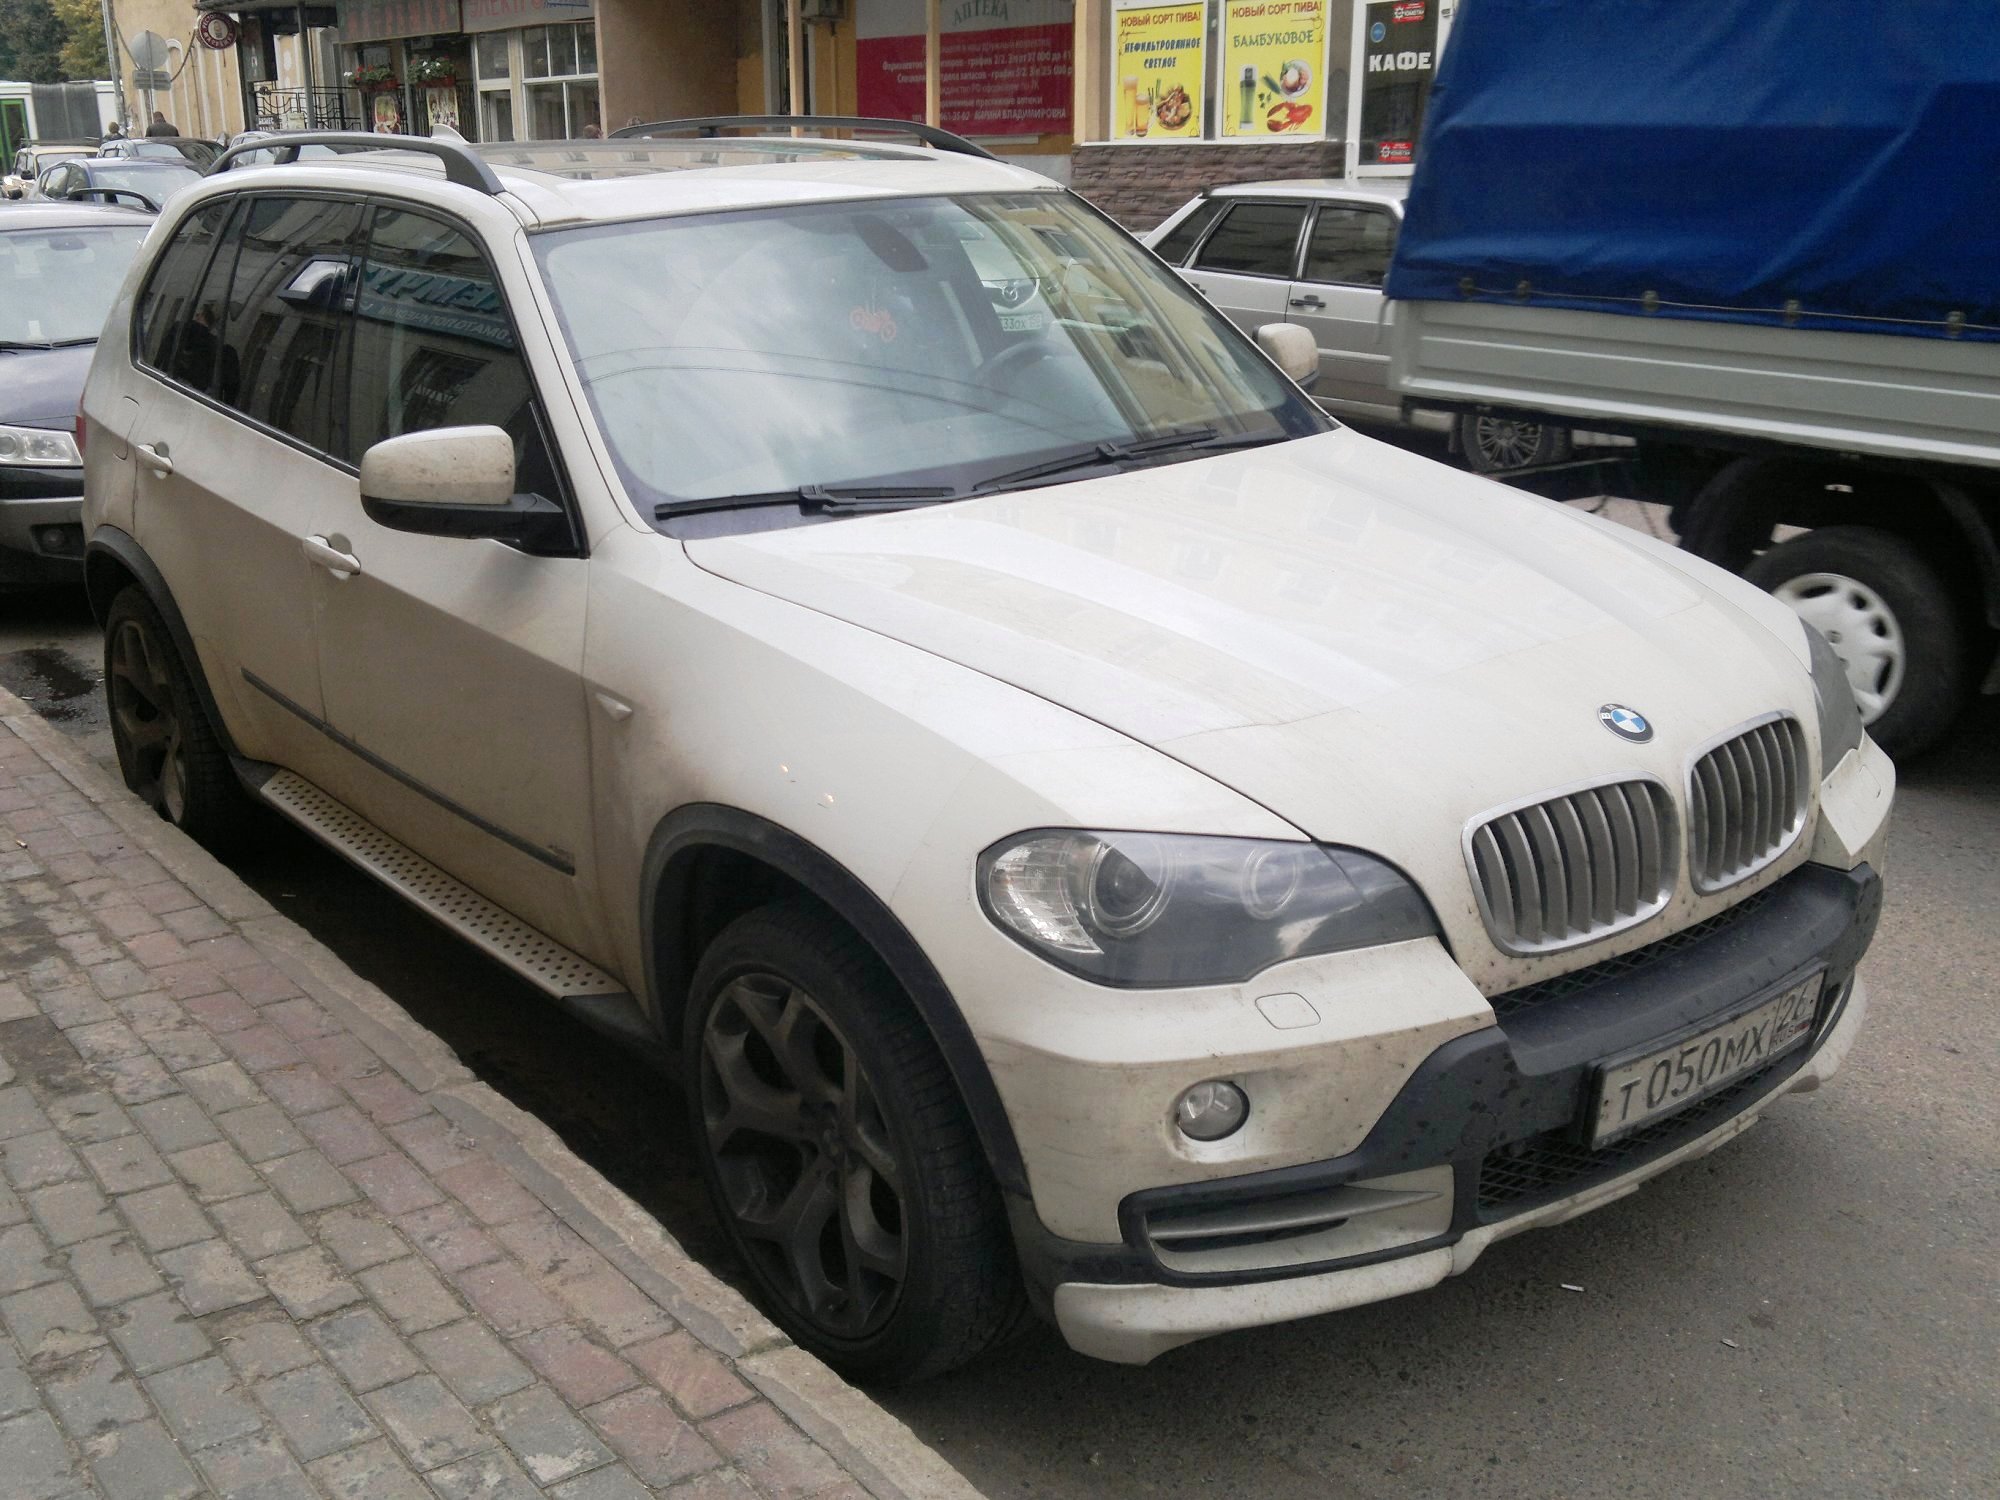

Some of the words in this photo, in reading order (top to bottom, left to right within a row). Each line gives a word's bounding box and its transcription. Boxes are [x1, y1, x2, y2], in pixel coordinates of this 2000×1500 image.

[1232, 5, 1266, 18] НОВЫЙ
[1267, 3, 1291, 16] СОРТ
[1293, 1, 1322, 14] ПИВА!
[1121, 14, 1151, 27] НОВЫЙ
[1152, 13, 1174, 25] СОРТ
[1175, 10, 1201, 22] ПИВА!
[1124, 37, 1200, 53] НЕФИЛЬТРОВАННОЕ
[1233, 29, 1315, 49] БАМБУКОВОЕ
[1144, 57, 1177, 69] СВЕТЛОЕ
[1369, 51, 1431, 72] КАФЕ
